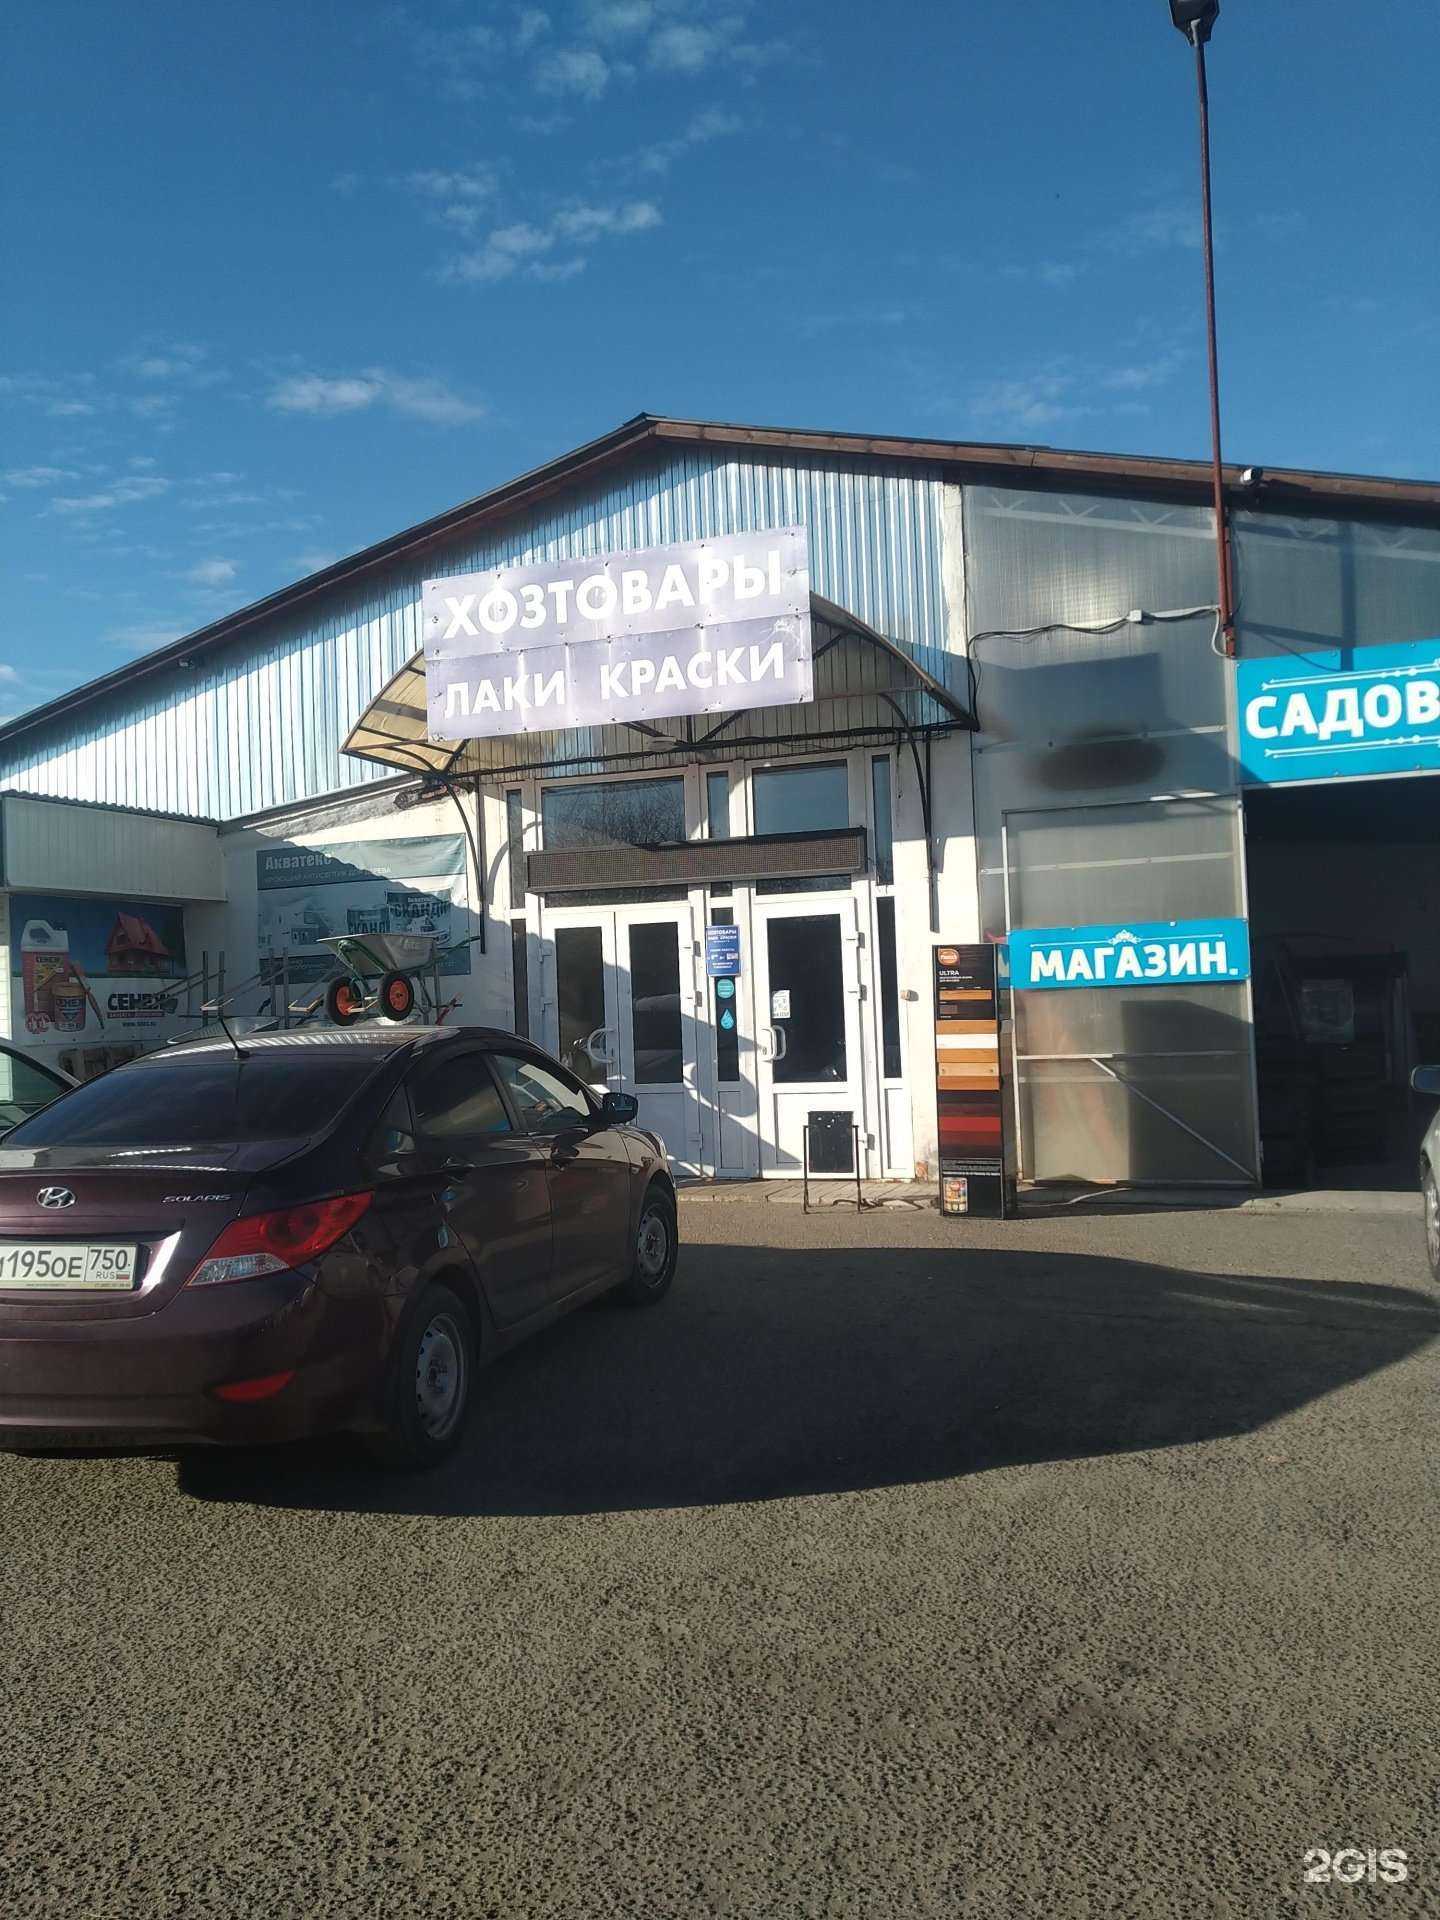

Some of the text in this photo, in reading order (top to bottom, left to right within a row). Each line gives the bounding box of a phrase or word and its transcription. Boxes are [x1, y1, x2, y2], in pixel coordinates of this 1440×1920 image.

[442, 550, 783, 640] ХОЗТОВАРЫ
[444, 642, 785, 720] ЛАКИ КРАСКИ
[1245, 679, 1440, 741] САДОВ
[1030, 941, 1239, 983] МАГАЗИН.
[162, 1194, 232, 1203] SOLARIS
[96, 1271, 115, 1280] RUS
